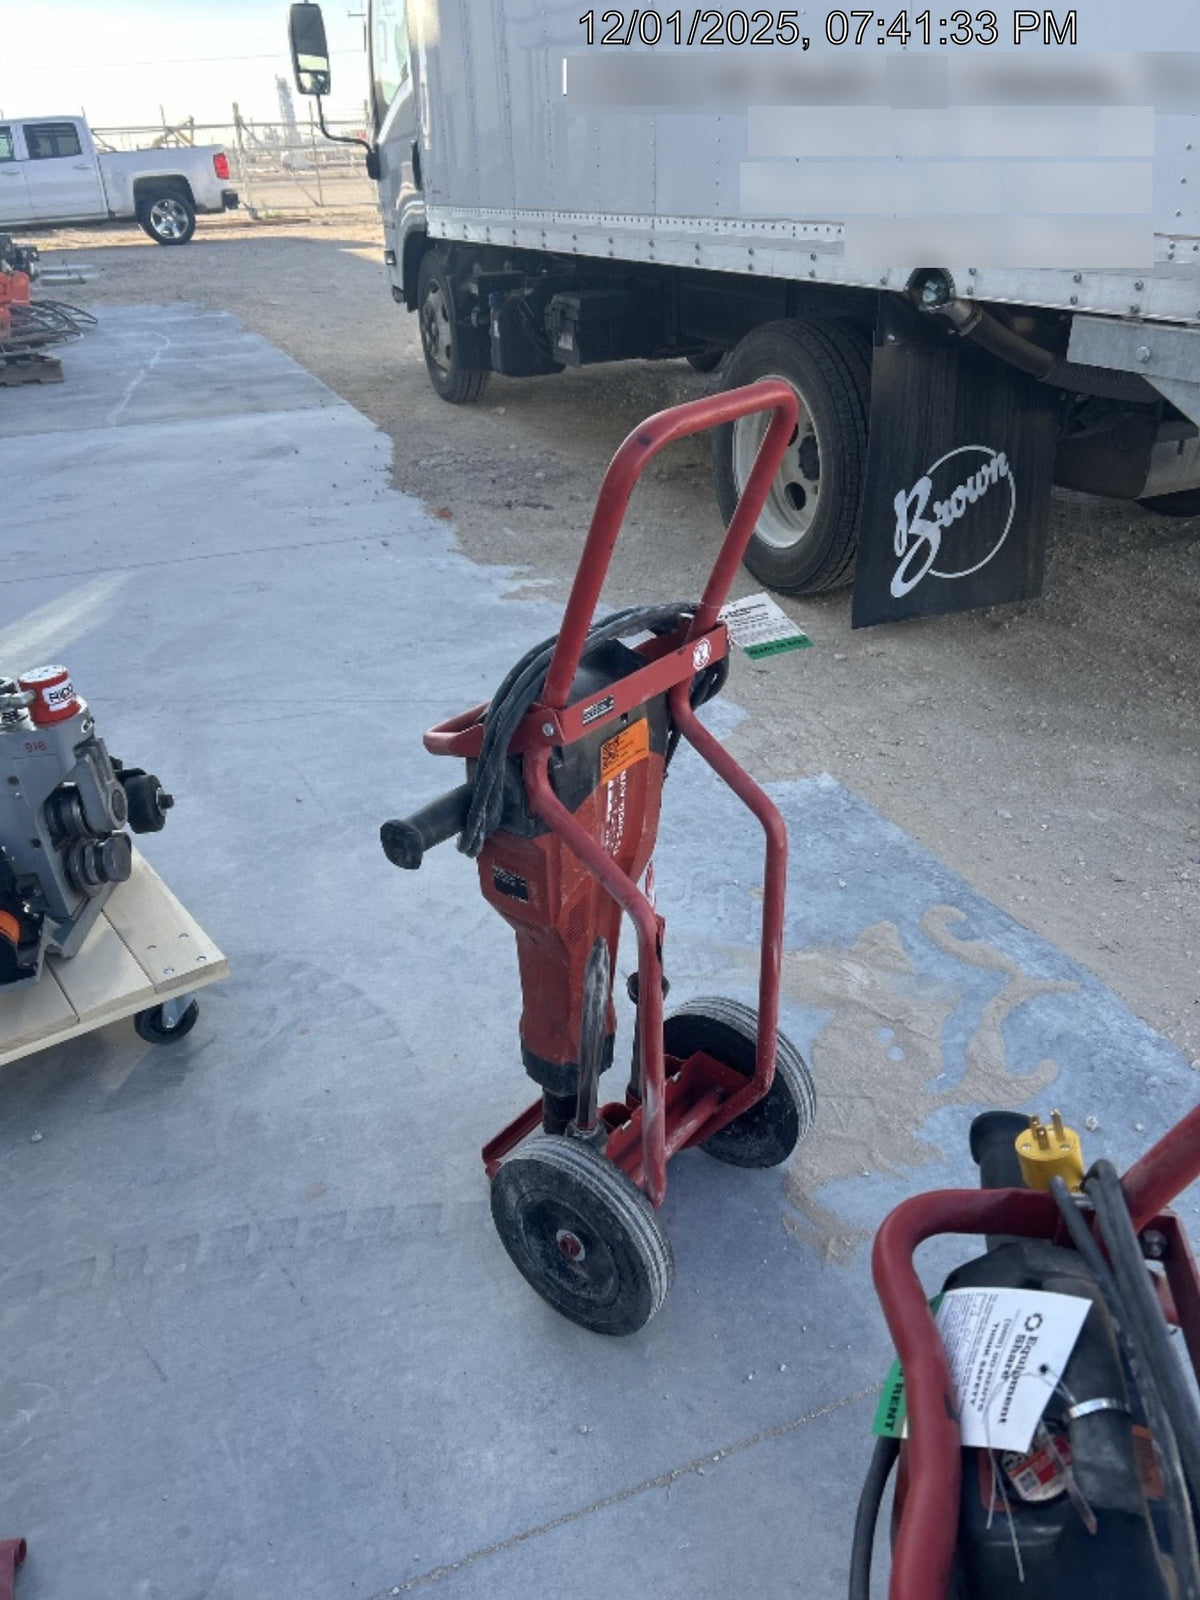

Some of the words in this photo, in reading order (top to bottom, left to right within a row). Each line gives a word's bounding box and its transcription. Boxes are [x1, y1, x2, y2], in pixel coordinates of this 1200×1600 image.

[891, 452, 1009, 598] Brown
[1000, 1335, 1039, 1423] Equipment
[1001, 1334, 1026, 1381] Share
[884, 1383, 905, 1432] RENT
[970, 1360, 986, 1406] SAFETY
